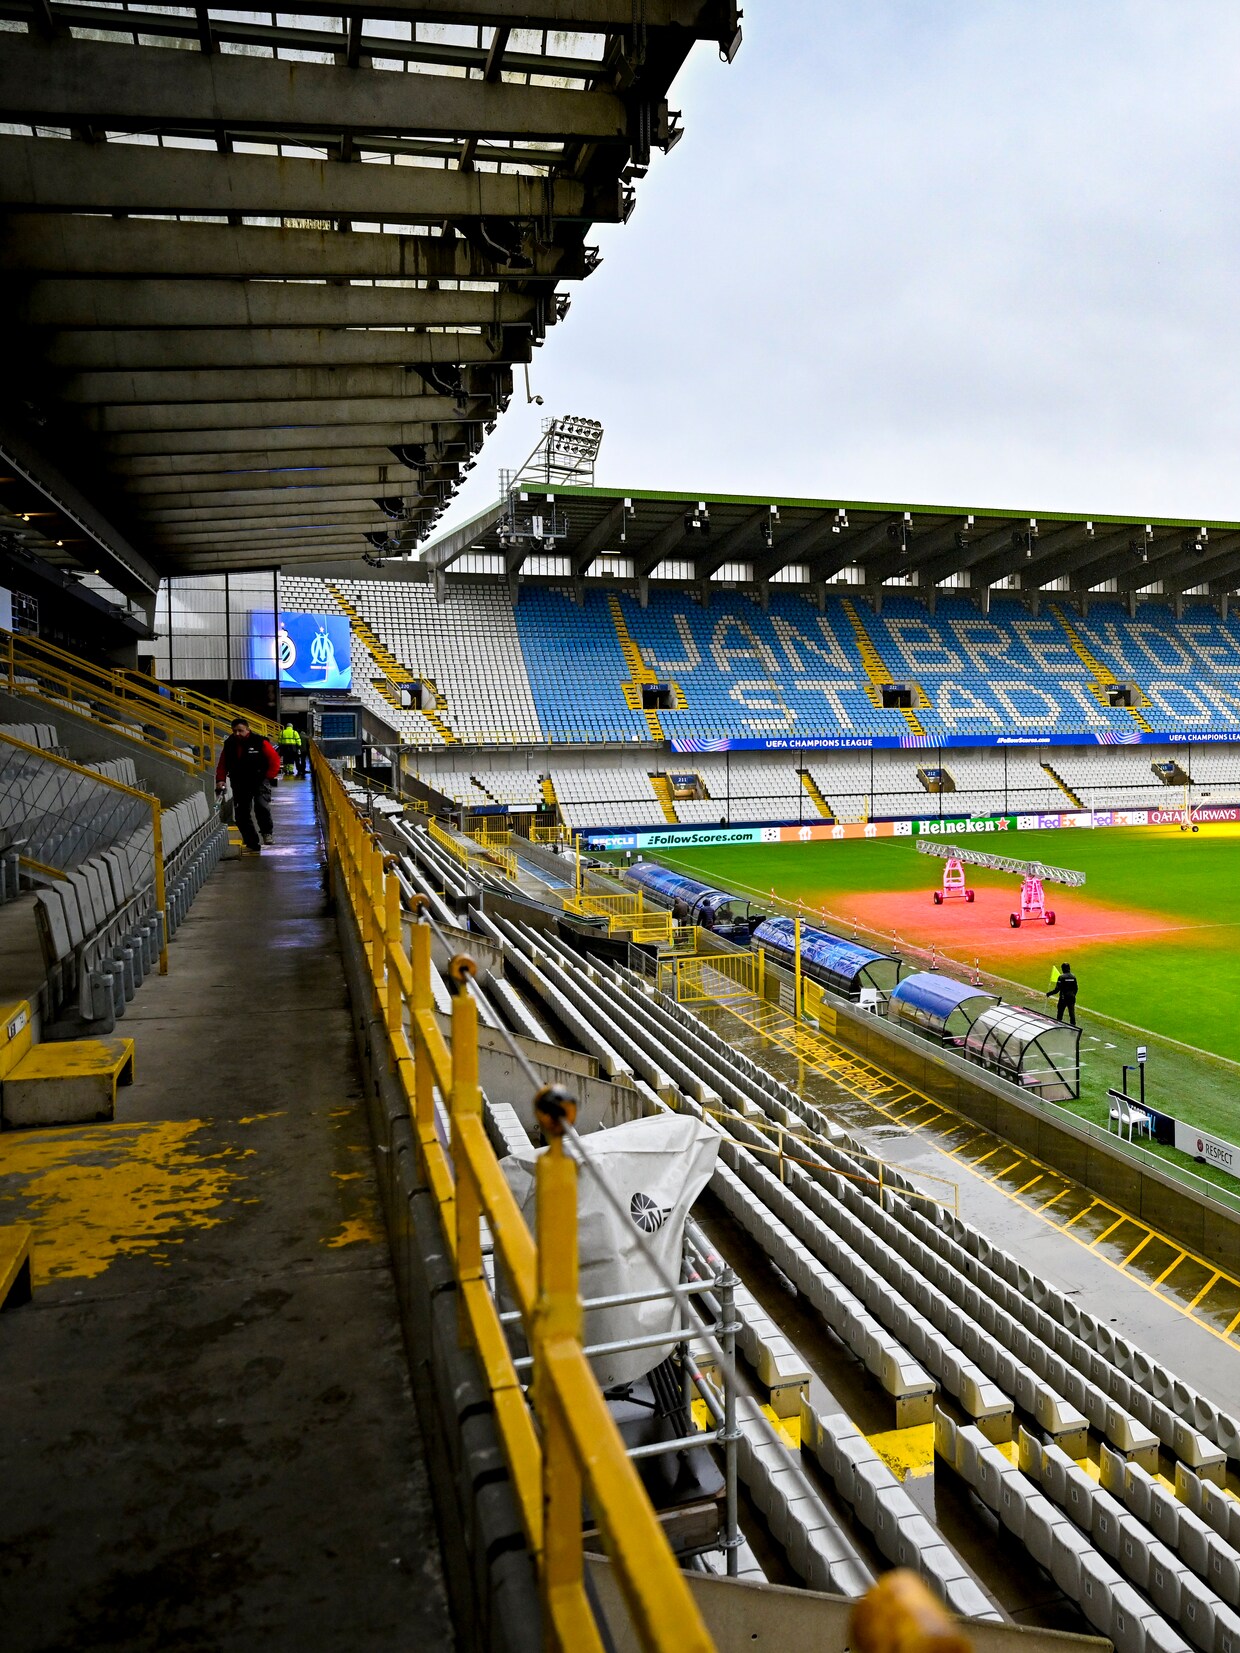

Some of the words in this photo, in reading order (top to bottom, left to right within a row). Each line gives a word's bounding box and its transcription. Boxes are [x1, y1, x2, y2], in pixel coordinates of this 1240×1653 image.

[641, 614, 853, 672] JAN
[766, 740, 787, 748] UEFA
[789, 740, 839, 748] CHAMPIONS
[841, 738, 873, 747] LEAGUE
[1187, 733, 1227, 741] CHAMPIONS
[1038, 814, 1076, 829] FedEx
[1192, 809, 1237, 821] AIRWAYS
[919, 818, 995, 835] Heineken
[593, 837, 634, 846] RECYCLE
[648, 832, 753, 846] FollowScores.com
[1205, 1142, 1233, 1166] RESPECT
